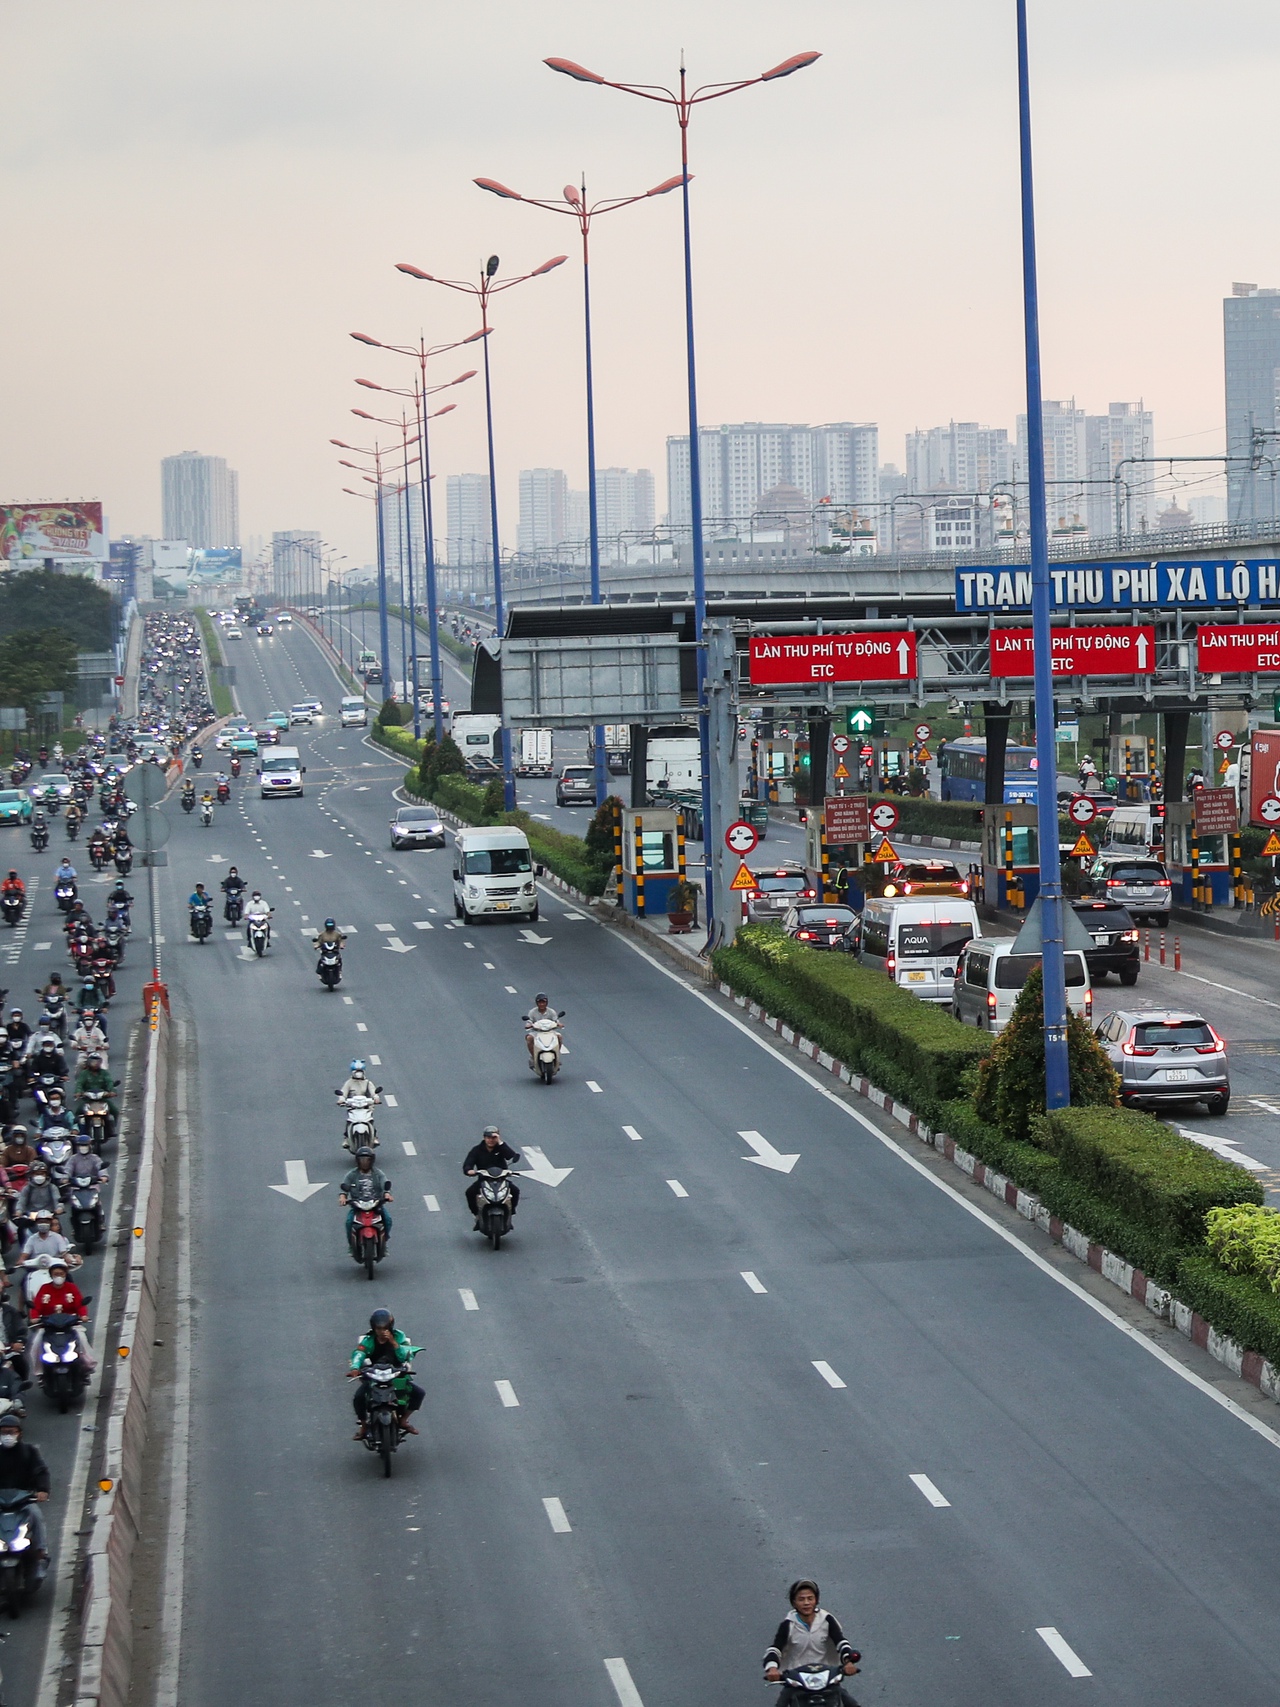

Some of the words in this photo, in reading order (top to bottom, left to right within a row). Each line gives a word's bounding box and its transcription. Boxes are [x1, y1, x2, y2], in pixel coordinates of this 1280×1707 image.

[1050, 570, 1103, 604] THU
[1112, 562, 1157, 603] PHÍ
[1167, 567, 1207, 602] XA
[1216, 561, 1250, 605] LỘ
[995, 636, 1021, 652] LÀN
[1053, 635, 1074, 650] PHÍ
[1075, 636, 1093, 652] TỰ
[1095, 634, 1130, 651] ĐỘNG
[1202, 632, 1227, 648] LÀN
[1230, 634, 1255, 647] THU
[1258, 631, 1278, 646] PHÍ
[755, 643, 781, 659] LÀN
[784, 644, 809, 658] THU
[813, 640, 834, 657] PHÍ
[836, 642, 853, 658] TỰ
[856, 639, 891, 657] ĐỘNG
[1051, 658, 1074, 670] ETC
[1257, 653, 1280, 666] ETC
[811, 664, 834, 677] ETC
[904, 936, 929, 944] AQUA
